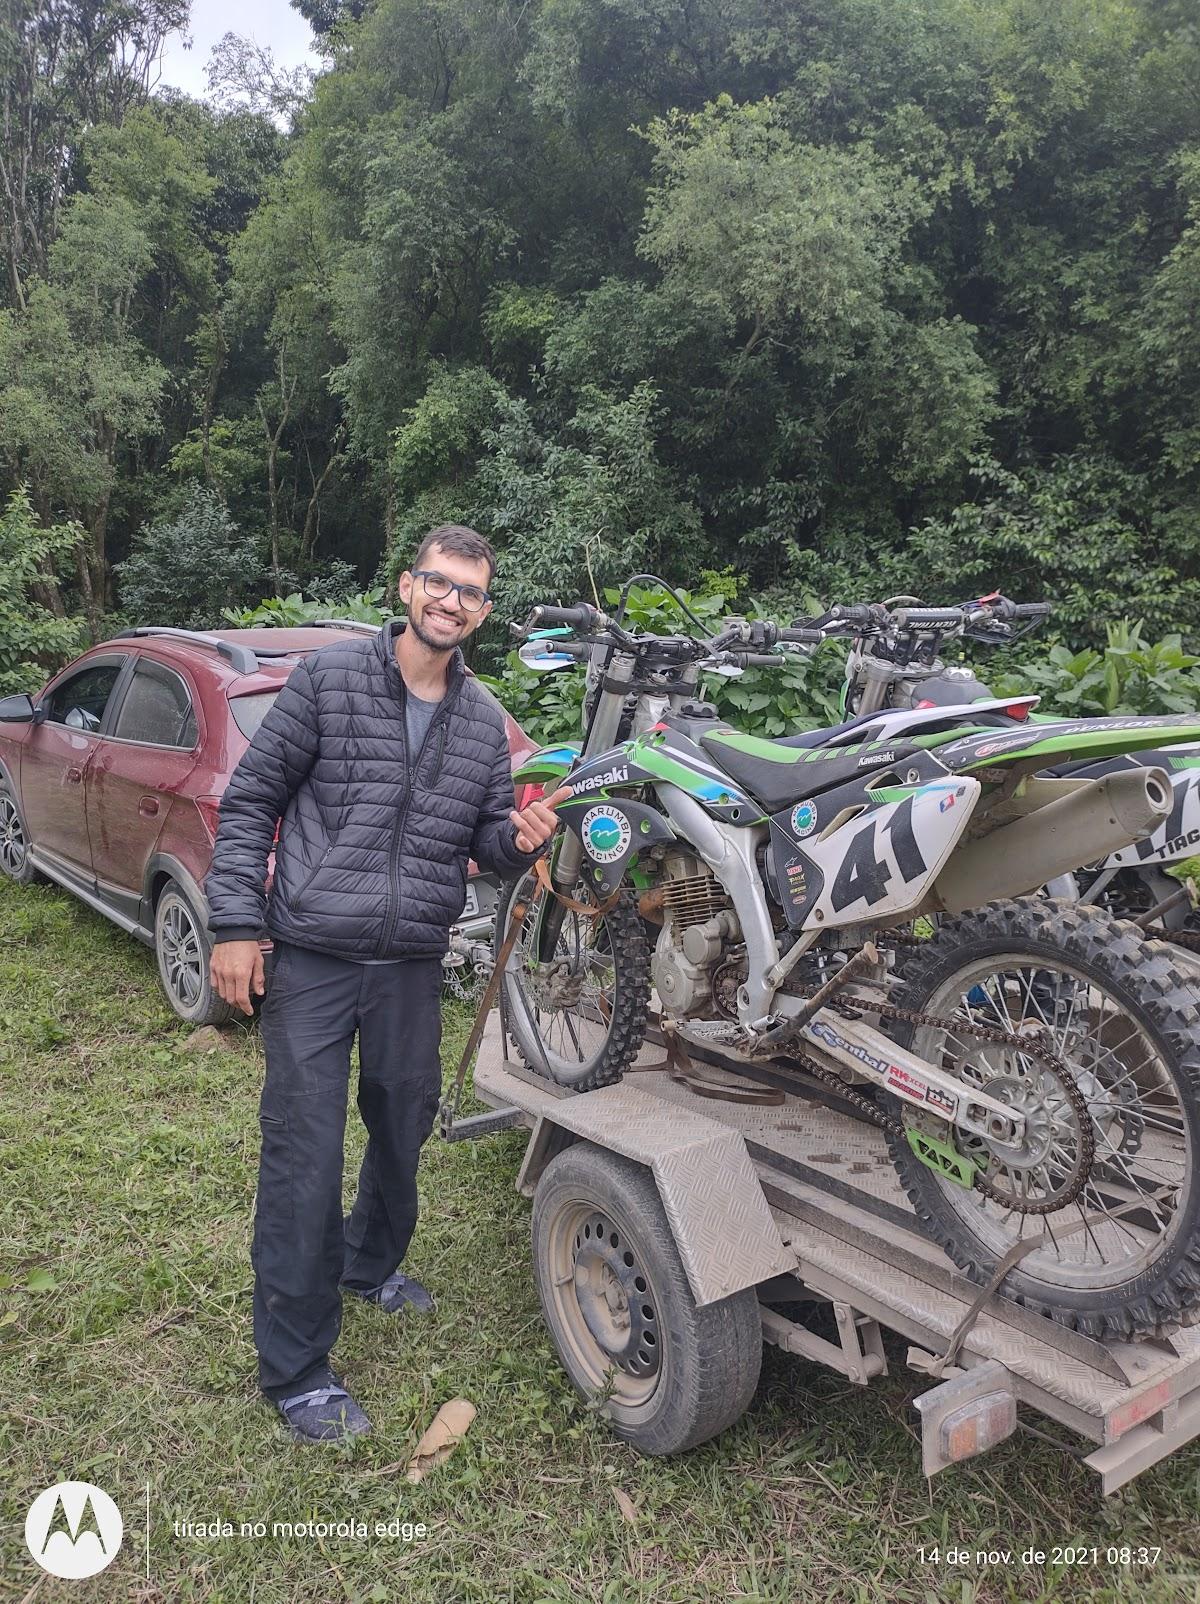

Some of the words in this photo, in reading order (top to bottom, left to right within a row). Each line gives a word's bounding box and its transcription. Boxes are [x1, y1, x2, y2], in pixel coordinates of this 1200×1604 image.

[858, 751, 895, 766] Kawasaki
[572, 764, 629, 795] wasaki
[583, 807, 630, 834] MARUMBI
[585, 841, 625, 860] RACING
[830, 792, 928, 914] 41
[811, 1021, 889, 1074] Renthal
